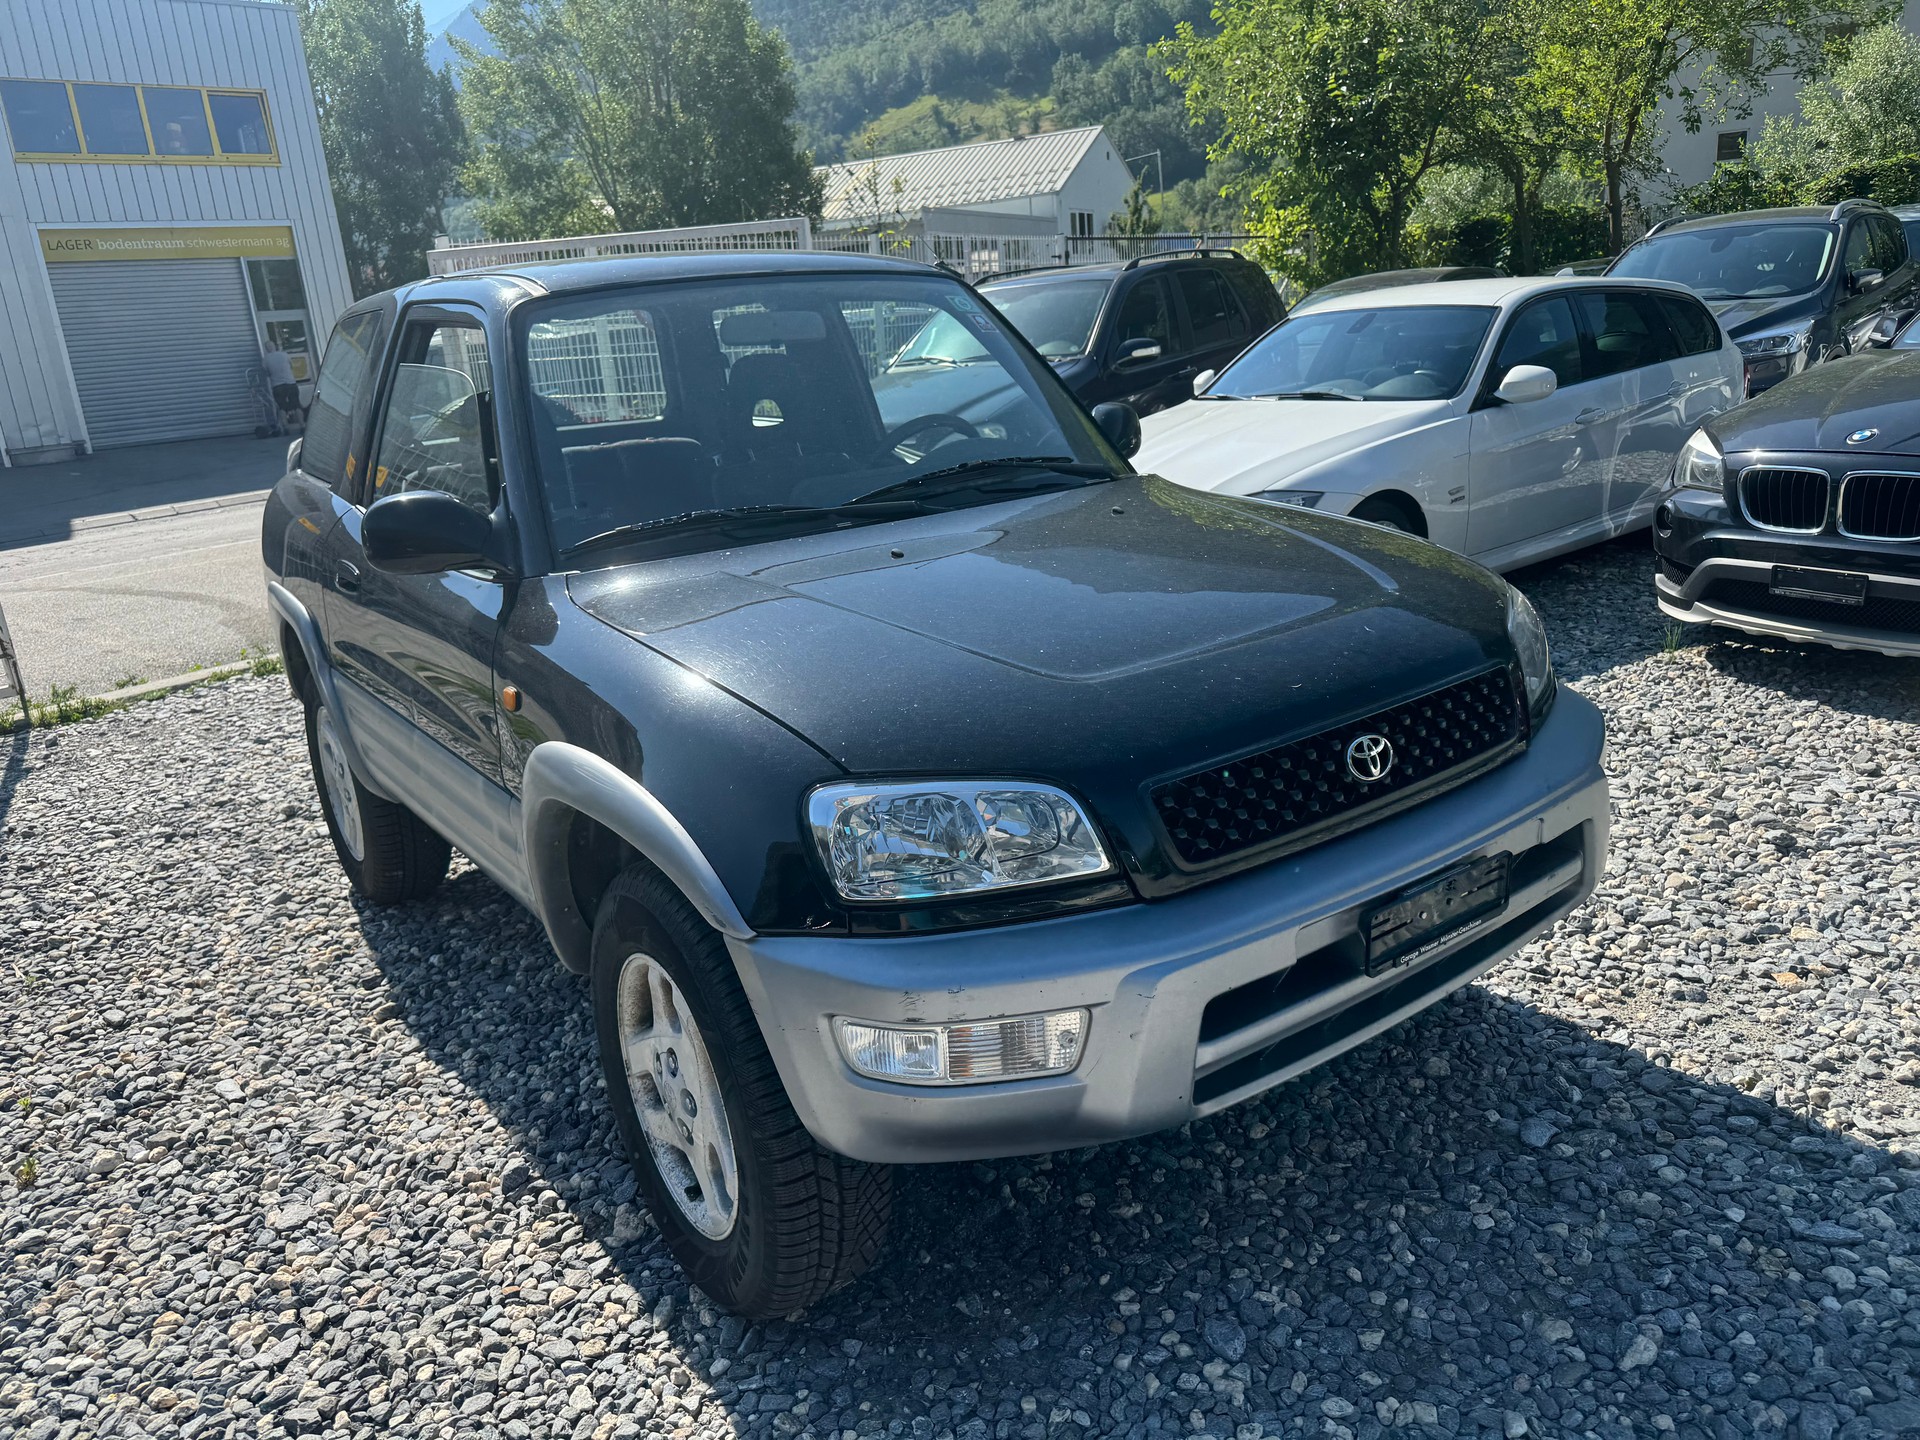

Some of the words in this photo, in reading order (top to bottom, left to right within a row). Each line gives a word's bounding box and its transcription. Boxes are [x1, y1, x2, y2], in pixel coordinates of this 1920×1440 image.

[47, 239, 93, 250] LAGER
[96, 238, 186, 250] bodentraum
[186, 236, 273, 248] schwestermann
[276, 236, 290, 248] ag
[1400, 950, 1419, 963] Garage
